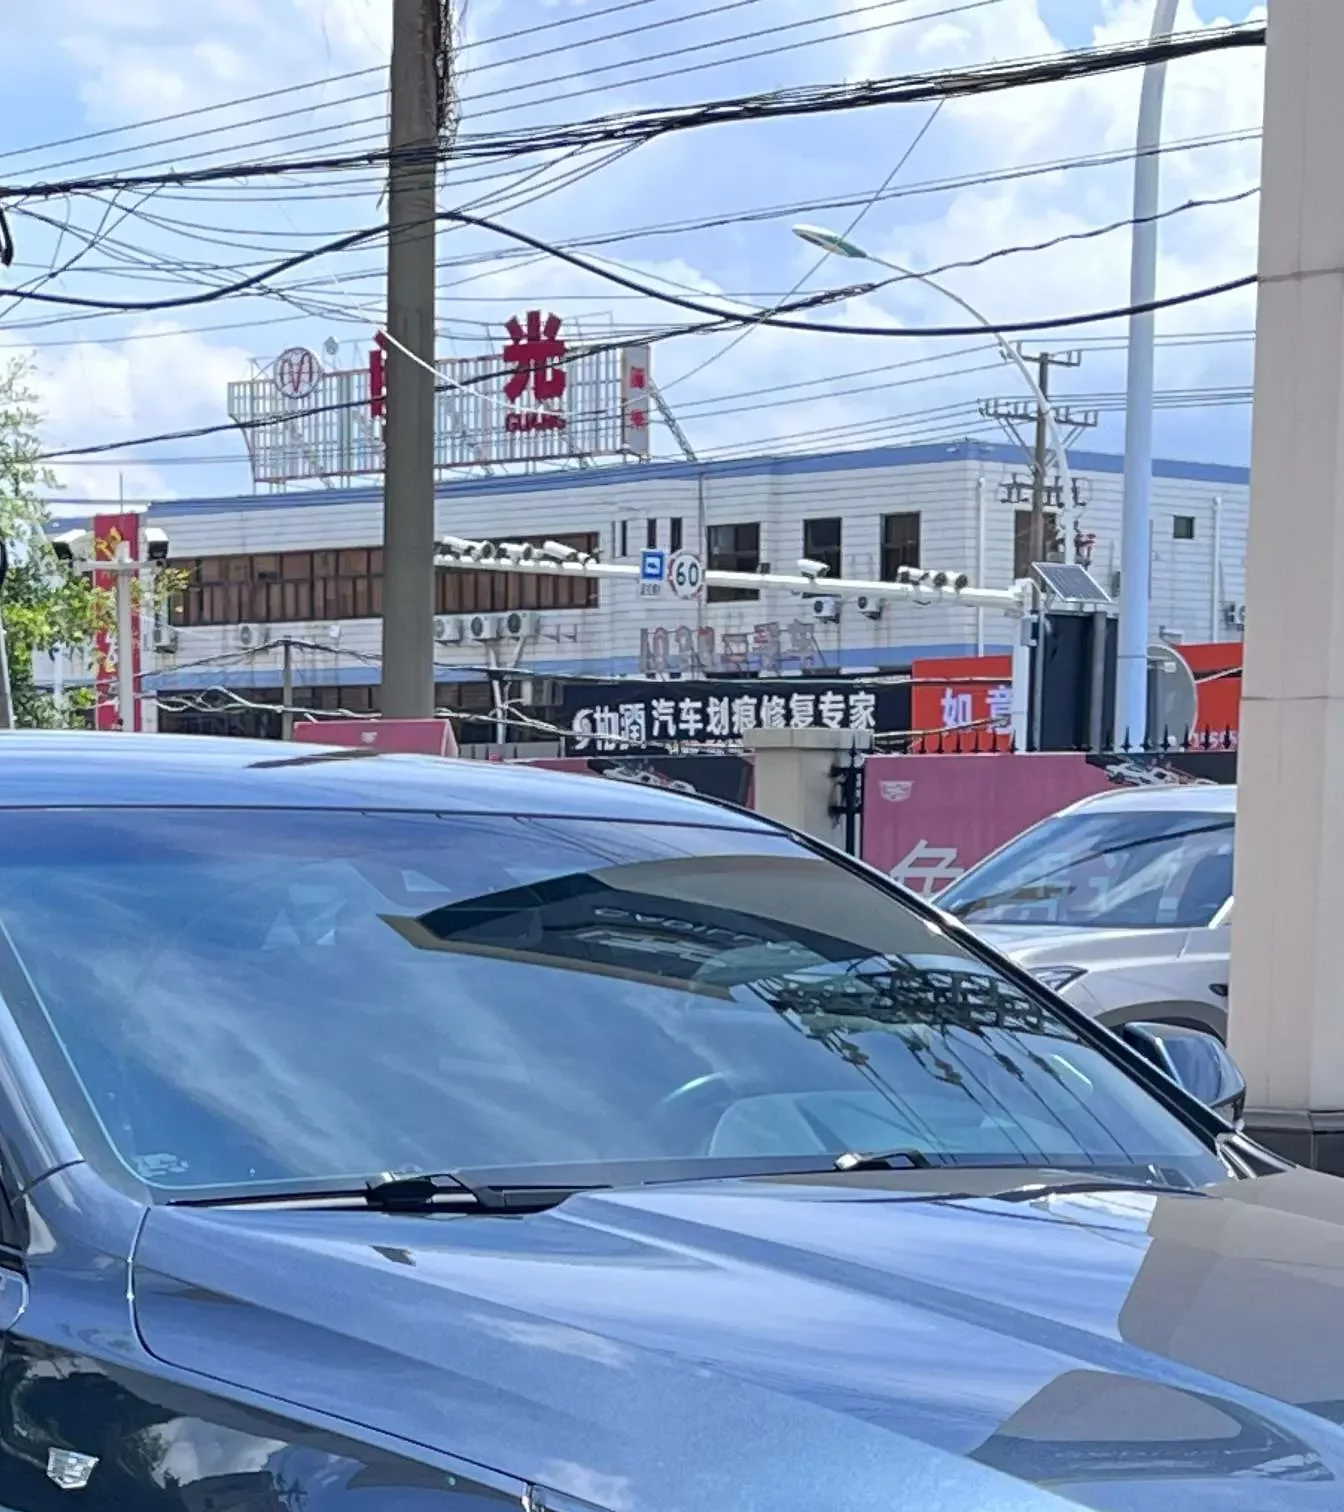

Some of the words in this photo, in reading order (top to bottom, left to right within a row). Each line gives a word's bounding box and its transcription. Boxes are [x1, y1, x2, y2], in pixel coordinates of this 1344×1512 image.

[503, 309, 567, 402] 光
[675, 561, 699, 587] 60
[651, 690, 876, 737] 汽车划痕修复专家
